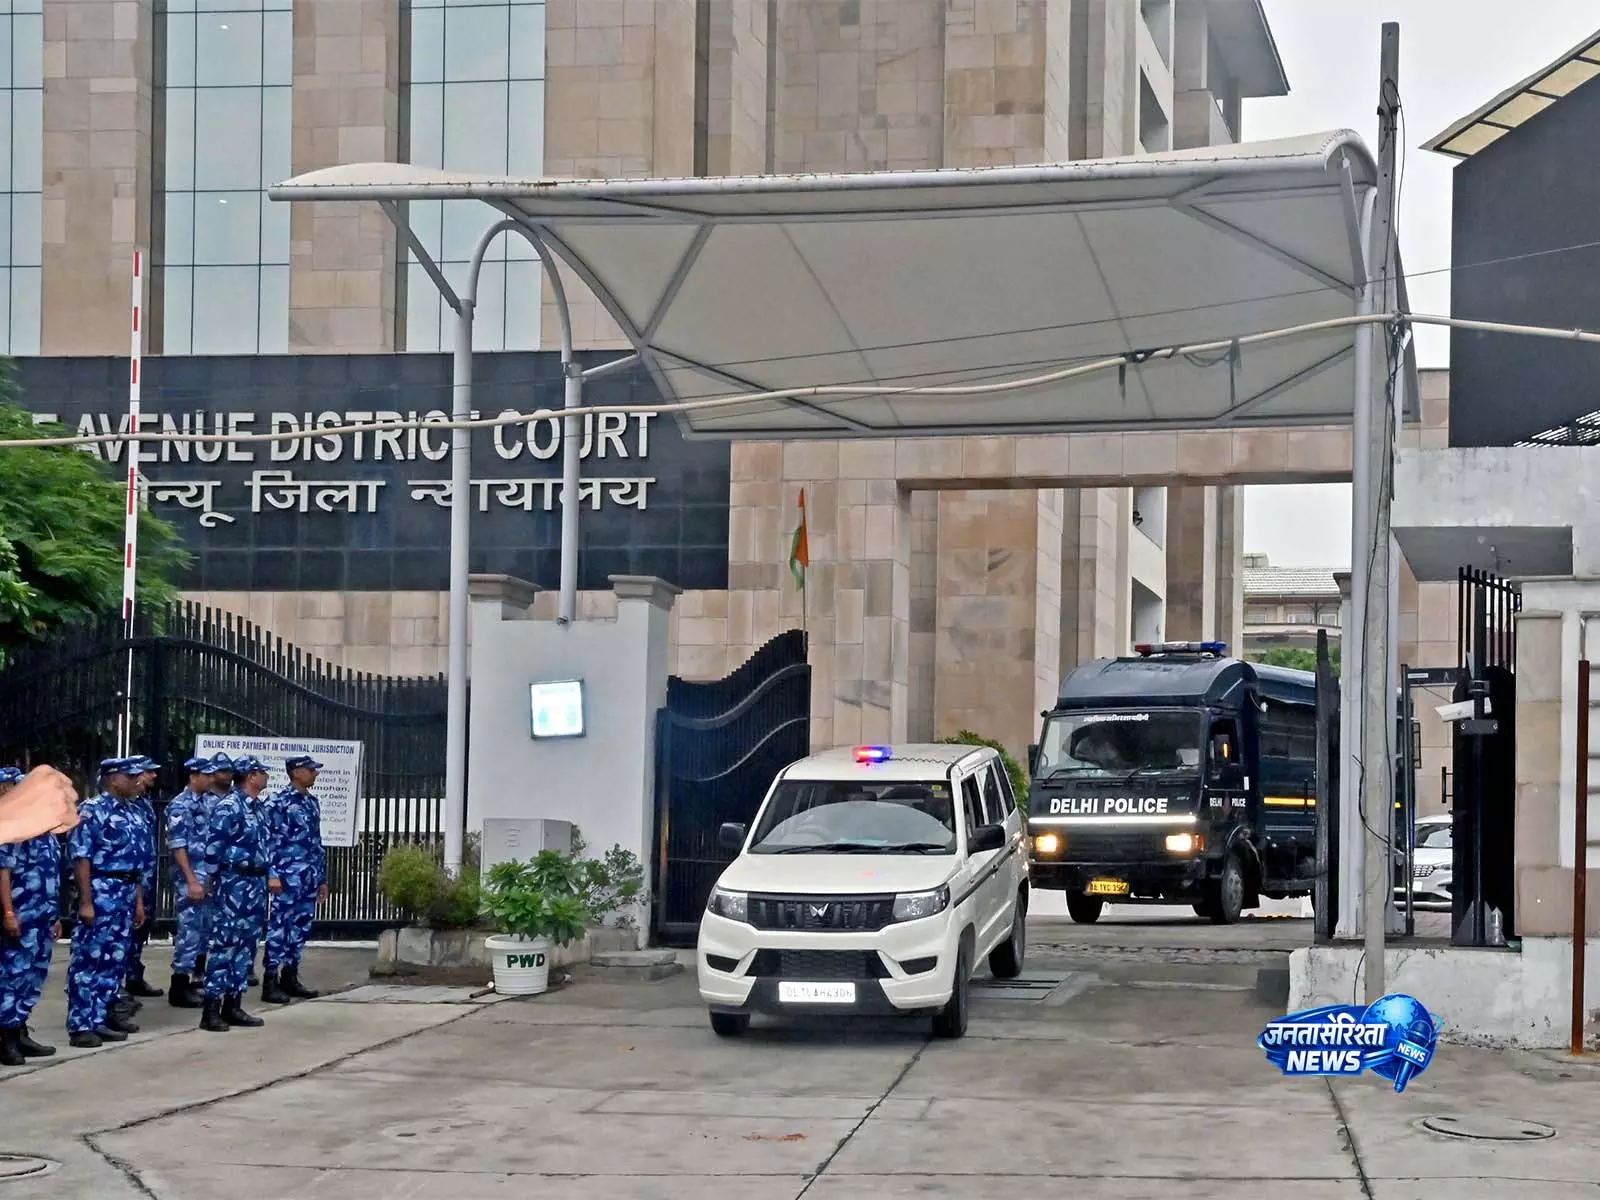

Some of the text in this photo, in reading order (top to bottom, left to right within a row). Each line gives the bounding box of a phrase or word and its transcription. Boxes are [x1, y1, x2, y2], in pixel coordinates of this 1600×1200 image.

[76, 412, 255, 462] AVENUE
[270, 410, 480, 462] DISTRIC
[244, 469, 386, 513] जिला
[203, 739, 355, 755] ONLINE FINE PAYMENT IN CRIMINAL JURISDICTION
[1050, 798, 1168, 814] DELHI POLICE
[1209, 798, 1246, 807] DELHI POLICE
[506, 953, 546, 969] PWD
